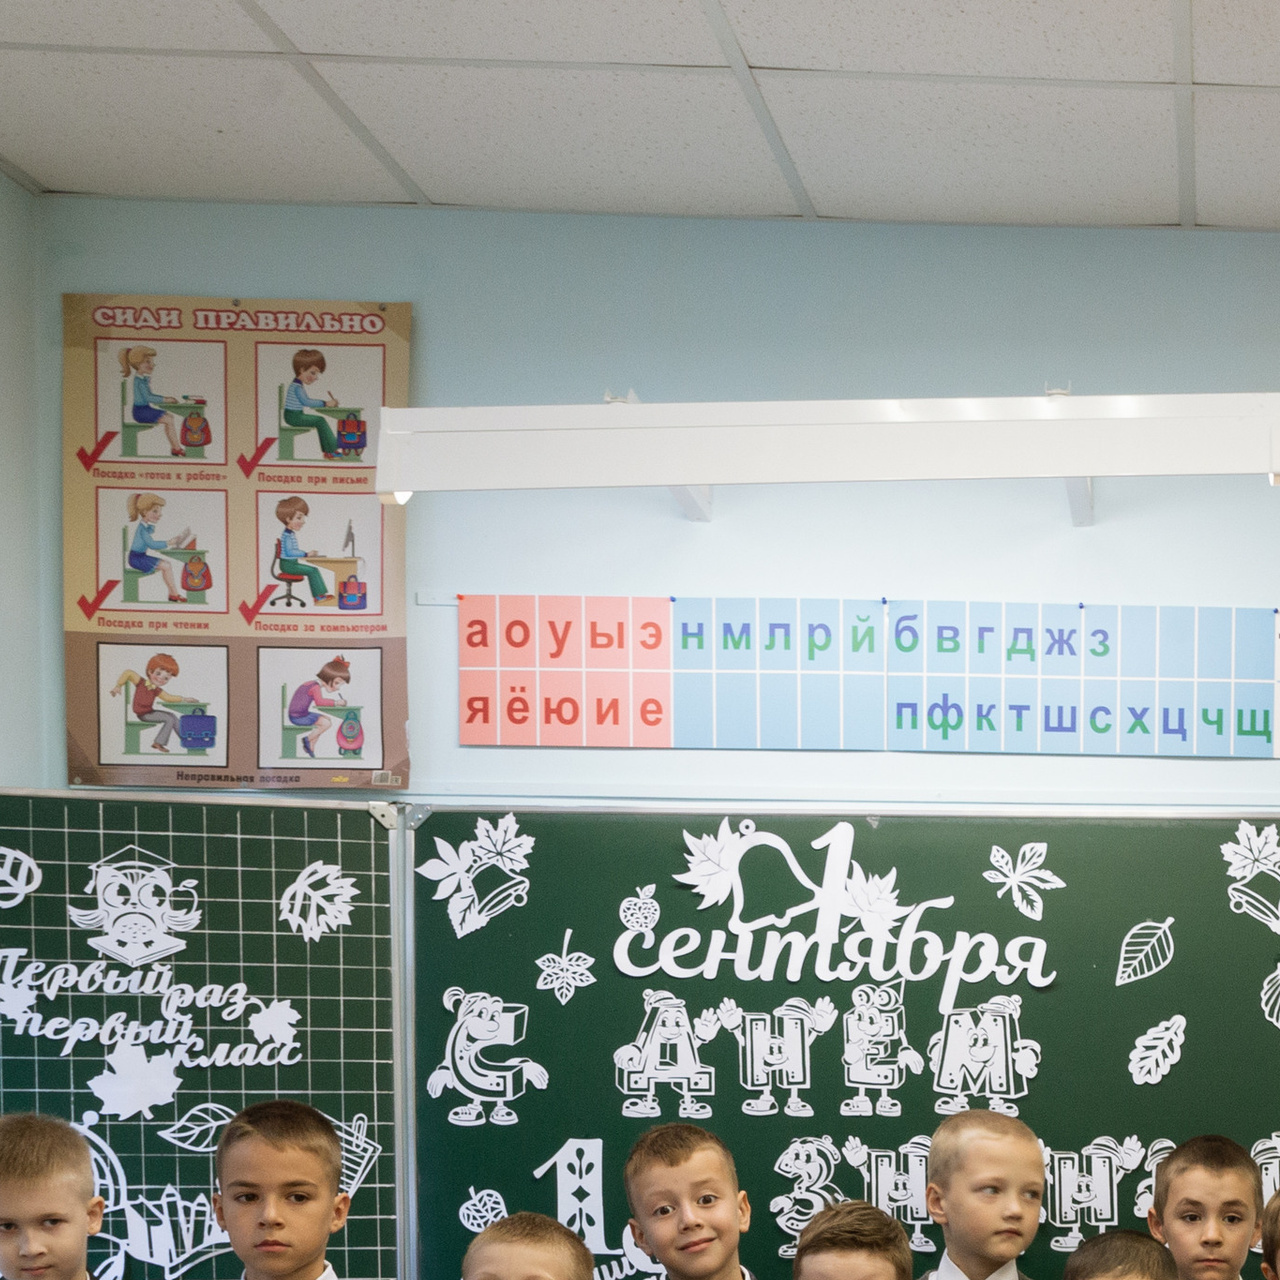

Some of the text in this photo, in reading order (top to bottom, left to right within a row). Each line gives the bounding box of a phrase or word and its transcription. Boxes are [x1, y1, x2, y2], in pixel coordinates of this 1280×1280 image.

[94, 307, 386, 335] СИДИ ПРАВИЛЬНО
[93, 468, 136, 480] Посадка
[257, 472, 303, 484] Посадка
[97, 617, 143, 629] Посадка
[254, 621, 299, 633] Посадка
[319, 624, 388, 634] компьютером
[466, 620, 489, 648] а
[548, 620, 573, 659] у
[590, 621, 625, 650] ы
[640, 621, 662, 650] э
[681, 622, 705, 650] н
[722, 622, 752, 650] м
[764, 623, 791, 651] л
[807, 623, 832, 661] р
[851, 614, 875, 653] й
[894, 614, 919, 652] б
[936, 626, 961, 653] в
[977, 627, 995, 653] г
[1006, 628, 1036, 662] д
[1044, 628, 1078, 656] ж
[1089, 629, 1110, 657] з
[465, 696, 490, 724] я
[506, 686, 530, 725] ё
[544, 696, 580, 725] ю
[595, 698, 620, 725] и
[640, 698, 663, 727] е
[896, 702, 918, 730] п
[927, 693, 964, 740] ф
[976, 704, 997, 731] к
[1008, 704, 1030, 732] т
[1044, 705, 1077, 733] ш
[1089, 706, 1112, 734] с
[1126, 707, 1150, 734] х
[1162, 707, 1187, 742] ц
[1201, 708, 1224, 736] ч
[1236, 709, 1272, 744] щ
[176, 771, 255, 783] Неправильная
[812, 821, 855, 943] 1
[613, 894, 1058, 1014] сентября
[161, 982, 248, 1021] раз
[14, 1010, 193, 1057] первый
